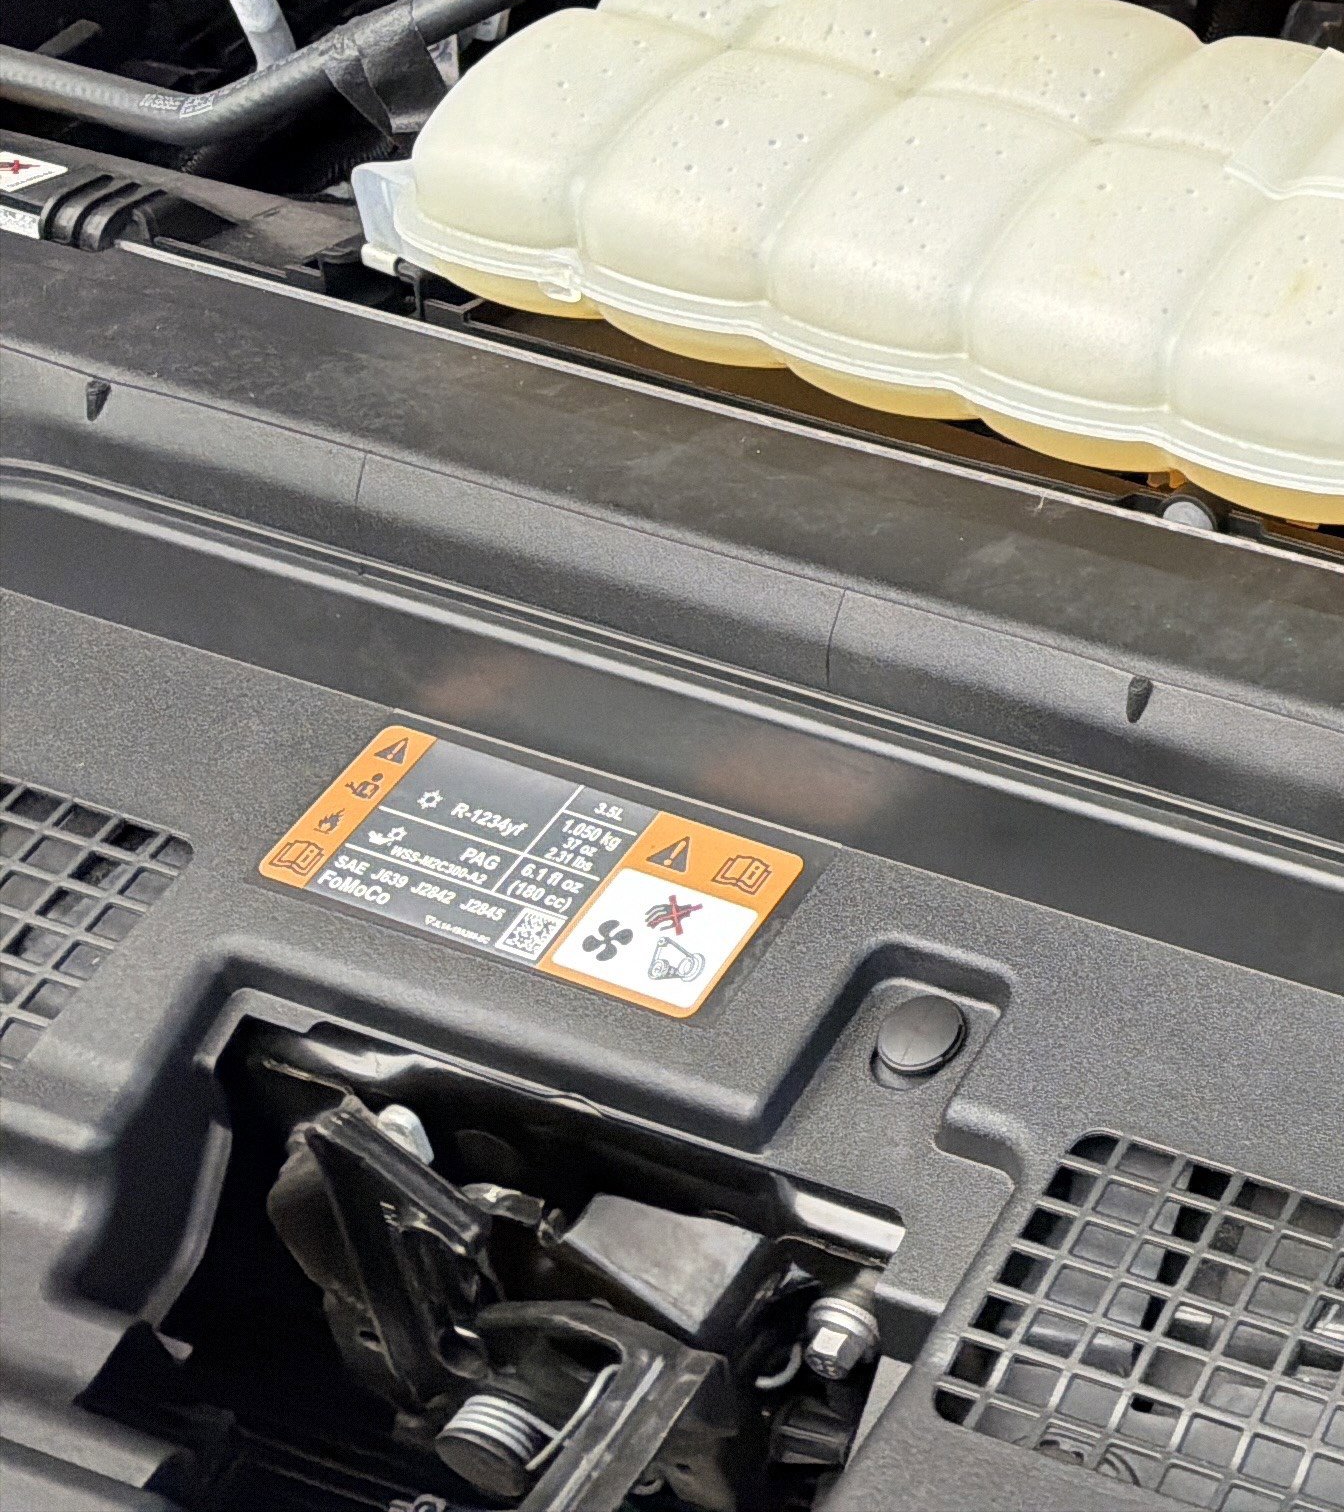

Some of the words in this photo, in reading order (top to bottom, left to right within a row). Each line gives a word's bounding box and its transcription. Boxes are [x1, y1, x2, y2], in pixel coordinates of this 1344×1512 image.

[450, 802, 529, 837] R-1234yf
[593, 802, 624, 822] 3.5L
[561, 819, 603, 841] 1.050
[599, 831, 622, 852] kg
[562, 837, 582, 850] 37
[579, 844, 598, 857] oz
[459, 847, 501, 871] PAG
[544, 846, 575, 865] 2.31
[571, 855, 593, 872] lbs
[317, 869, 391, 905] FoMoCo
[334, 855, 371, 876] SAE
[370, 868, 408, 888] J639
[410, 882, 456, 905] J2842
[459, 898, 507, 922] J2845
[520, 863, 548, 882] 6.1
[546, 871, 564, 886] fl
[561, 879, 584, 894] oz
[506, 880, 546, 901] (180
[543, 894, 573, 913] cc)
